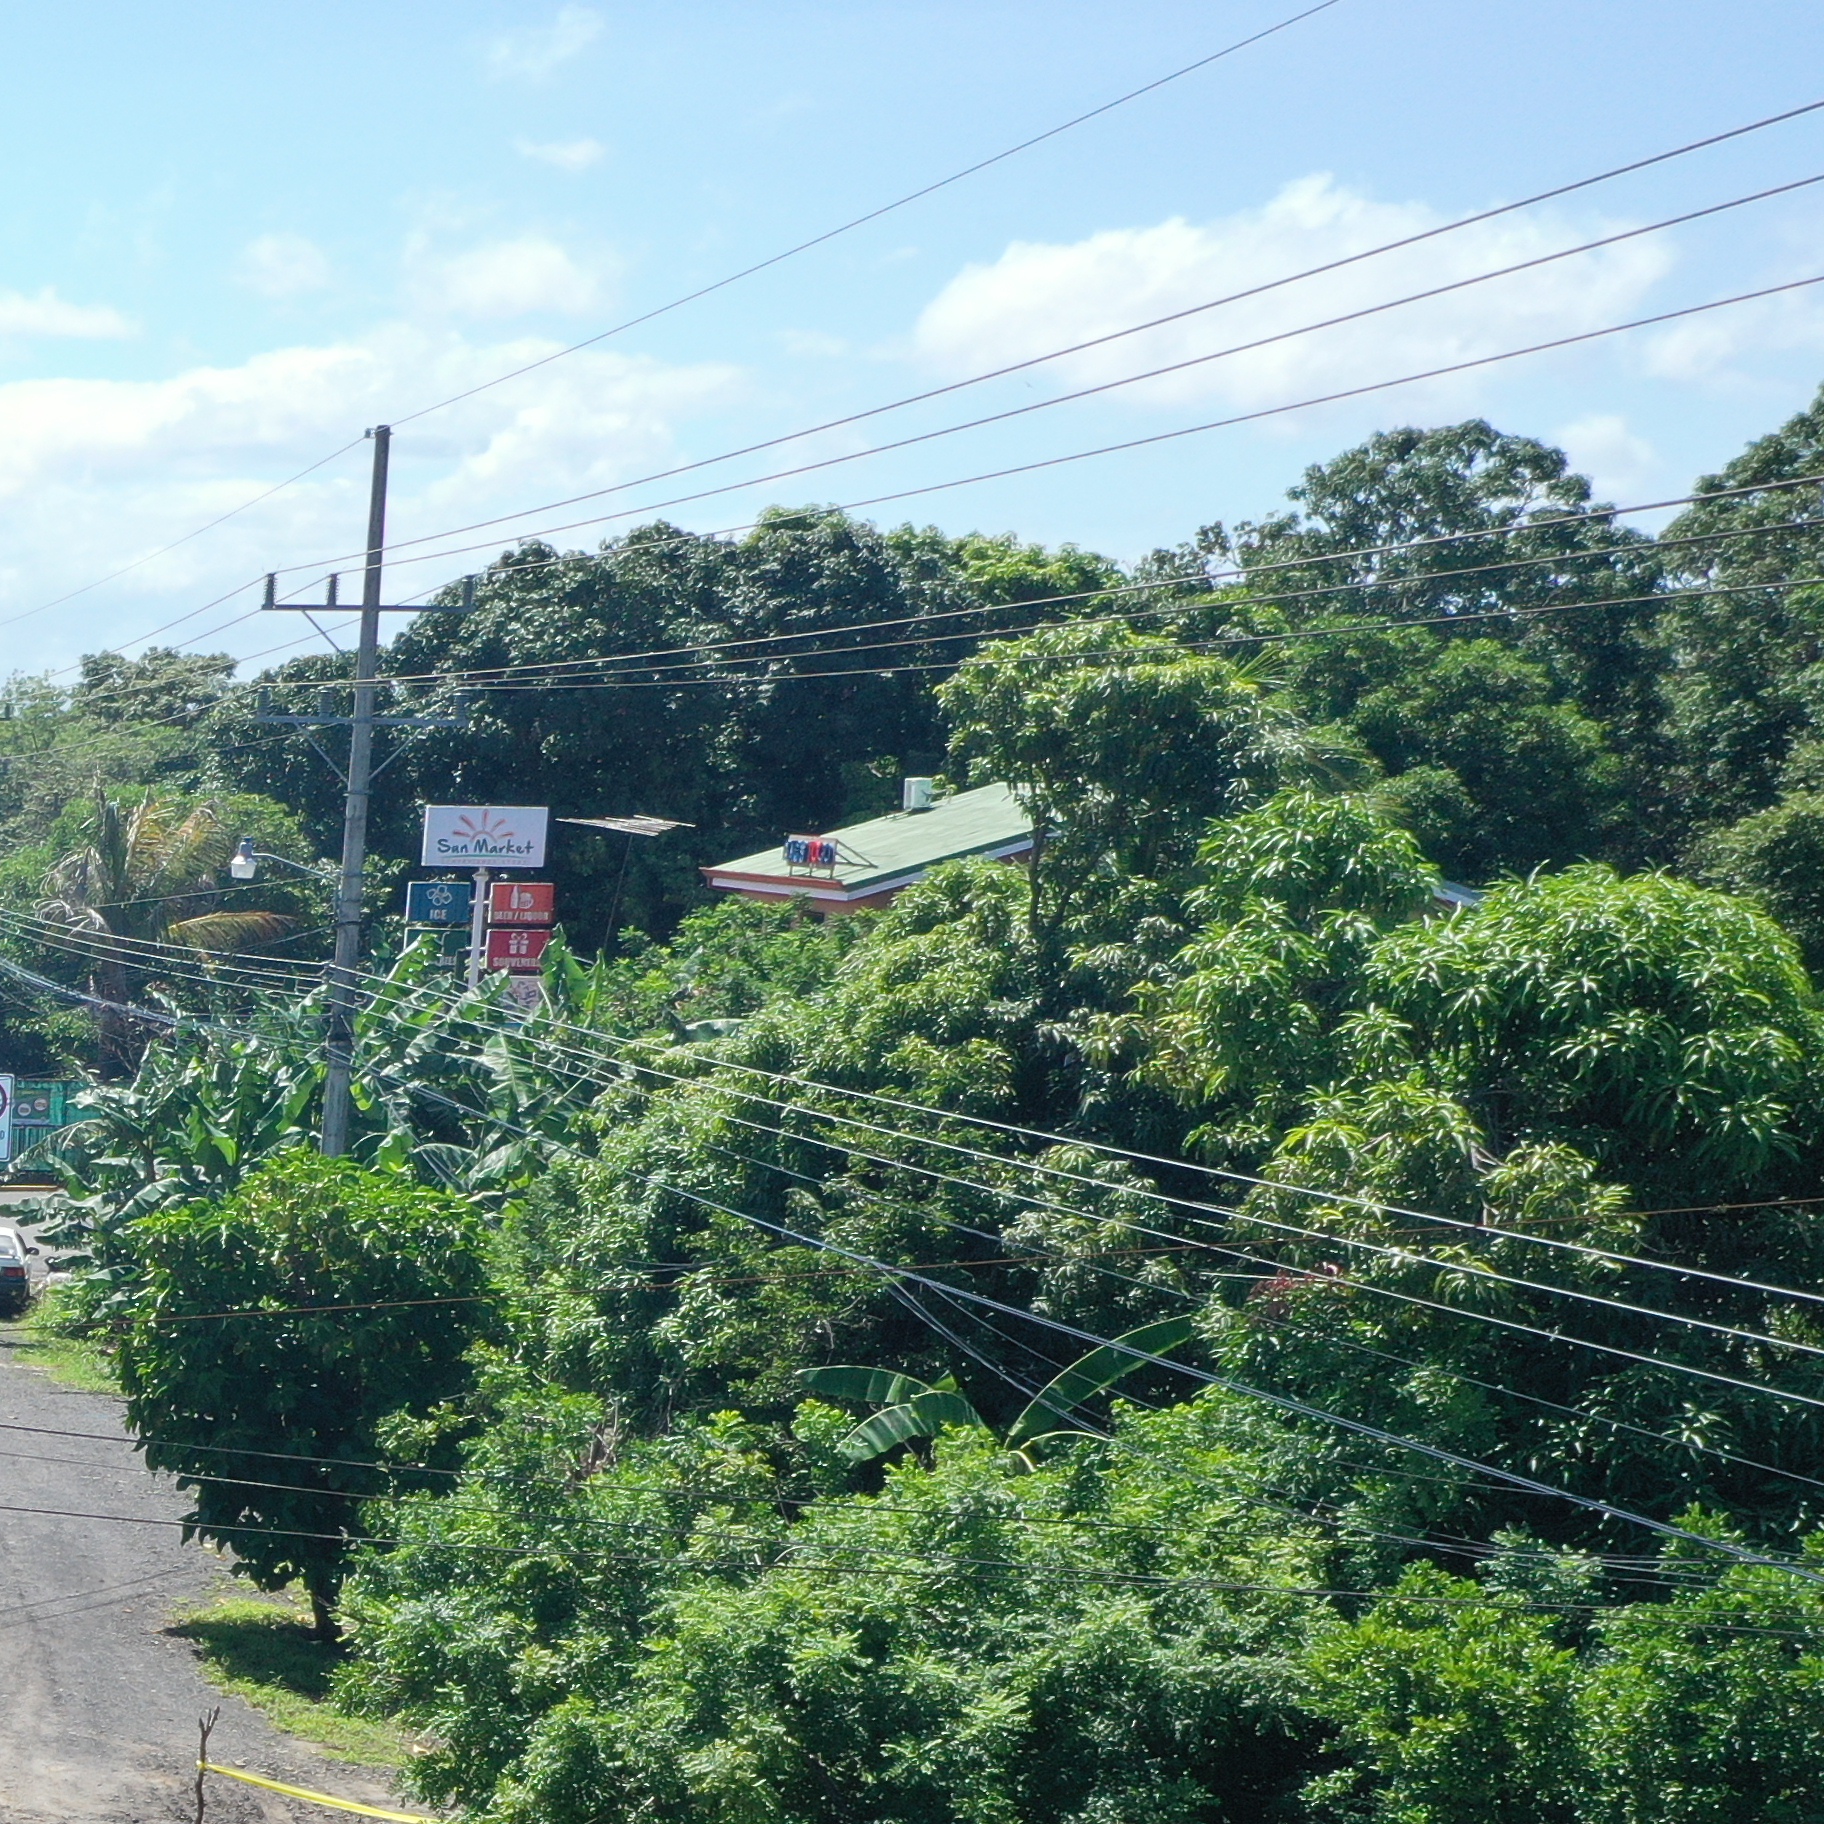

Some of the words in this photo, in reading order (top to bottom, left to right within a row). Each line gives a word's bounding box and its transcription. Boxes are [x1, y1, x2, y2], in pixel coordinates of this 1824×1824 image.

[437, 839, 469, 853] Sun
[473, 839, 534, 854] Market
[430, 910, 447, 920] ICE
